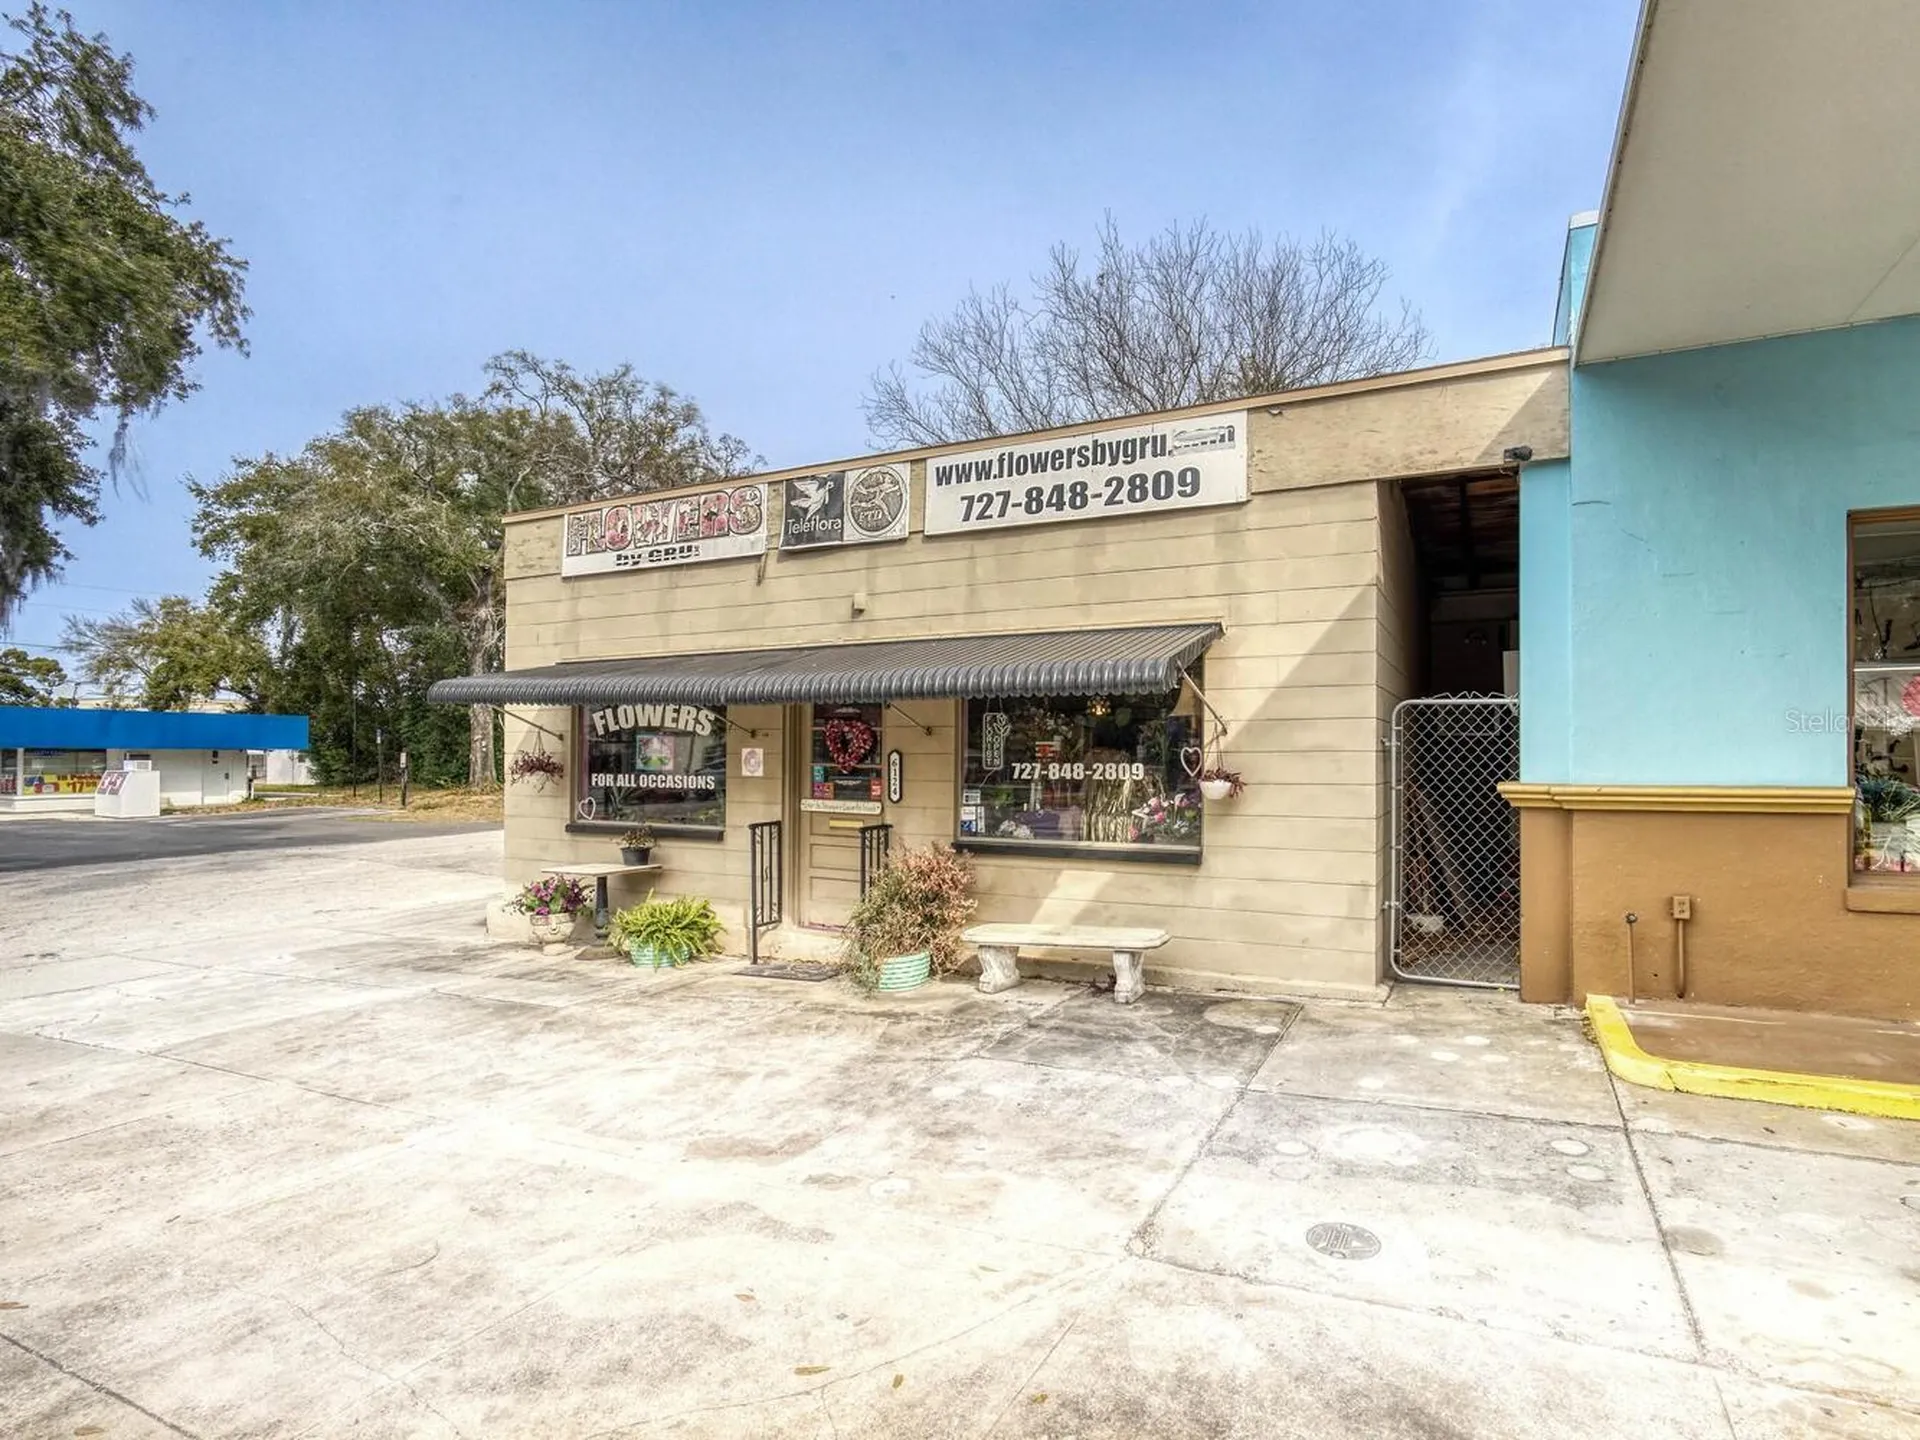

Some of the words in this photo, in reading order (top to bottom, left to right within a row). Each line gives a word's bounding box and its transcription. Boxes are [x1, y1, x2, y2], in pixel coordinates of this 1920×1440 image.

[960, 466, 1201, 522] 727-848-2809
[566, 485, 762, 556] FLOWERS
[786, 515, 842, 535] Teleflora
[592, 704, 716, 737] FLOWERS
[592, 773, 615, 787] FOR
[616, 773, 637, 788] ALL
[639, 774, 716, 790] OCCASIONS
[891, 758, 899, 796] 6124
[1012, 762, 1145, 780] 727-848-2809
